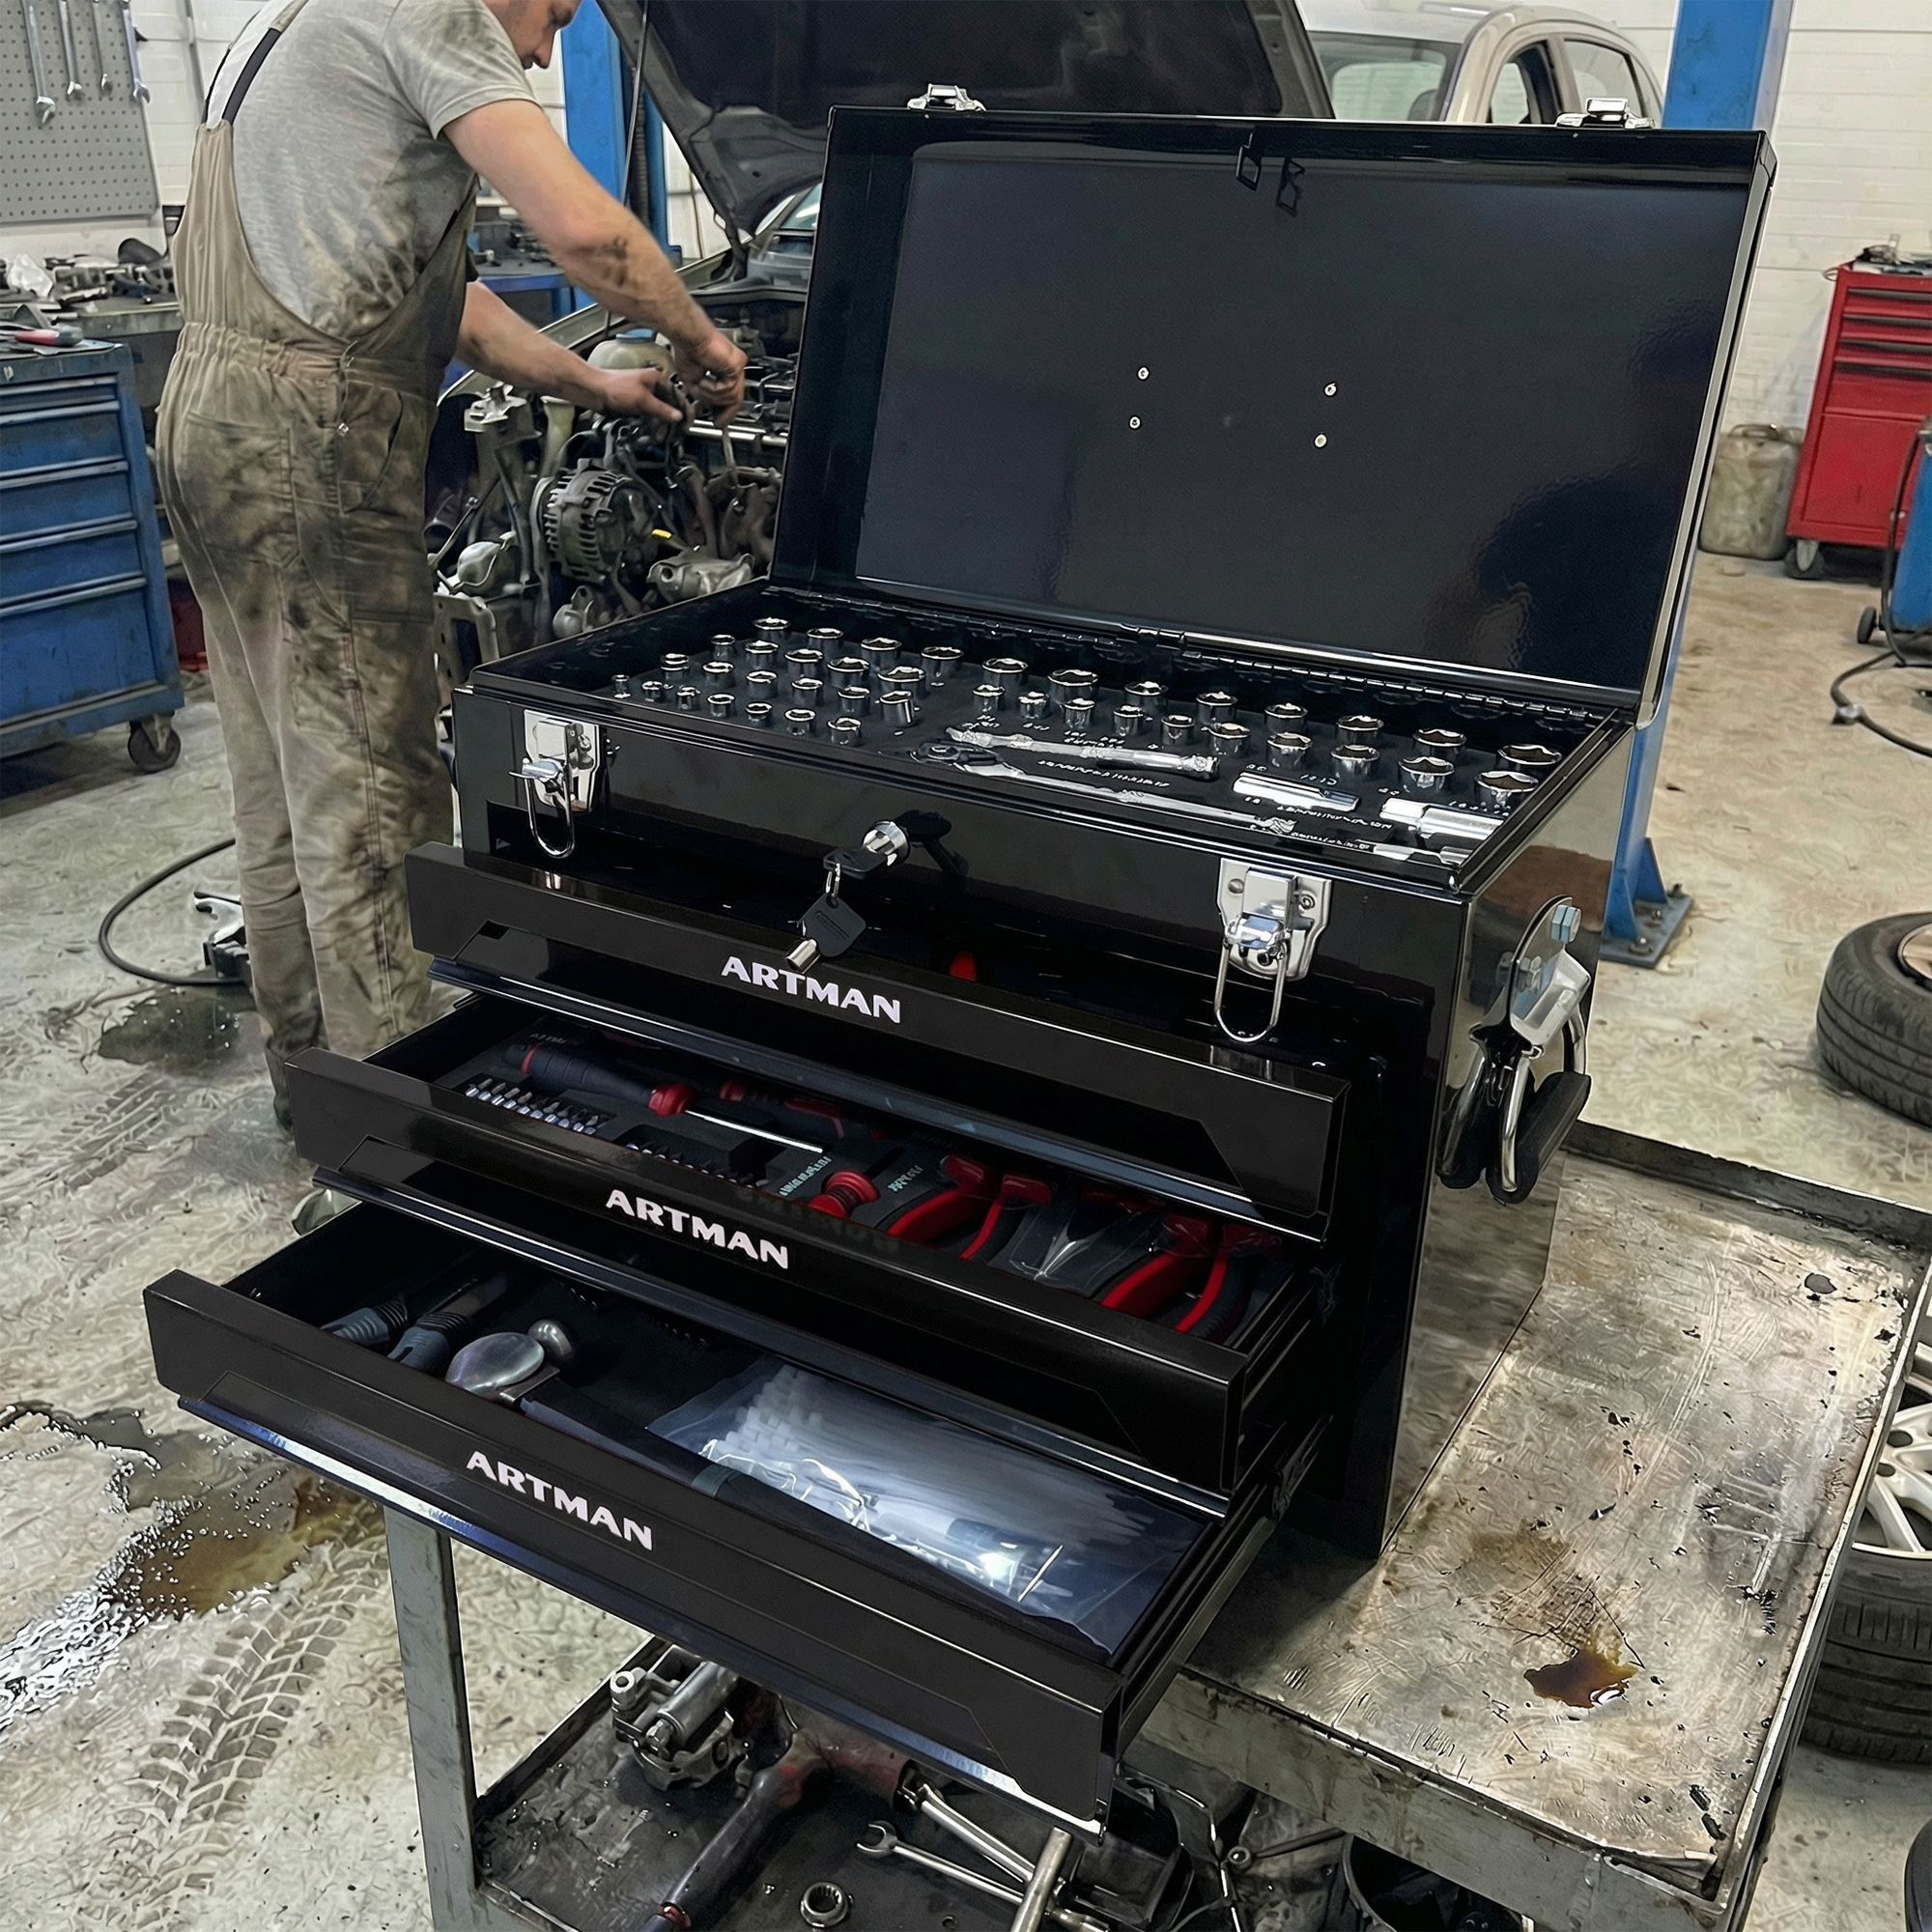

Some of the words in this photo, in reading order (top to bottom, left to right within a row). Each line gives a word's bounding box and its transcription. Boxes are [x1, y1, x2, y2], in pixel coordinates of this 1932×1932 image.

[721, 955, 901, 1024] ARTMAN
[605, 1189, 789, 1269] ARTMAN
[466, 1450, 653, 1551] ARTMAN
